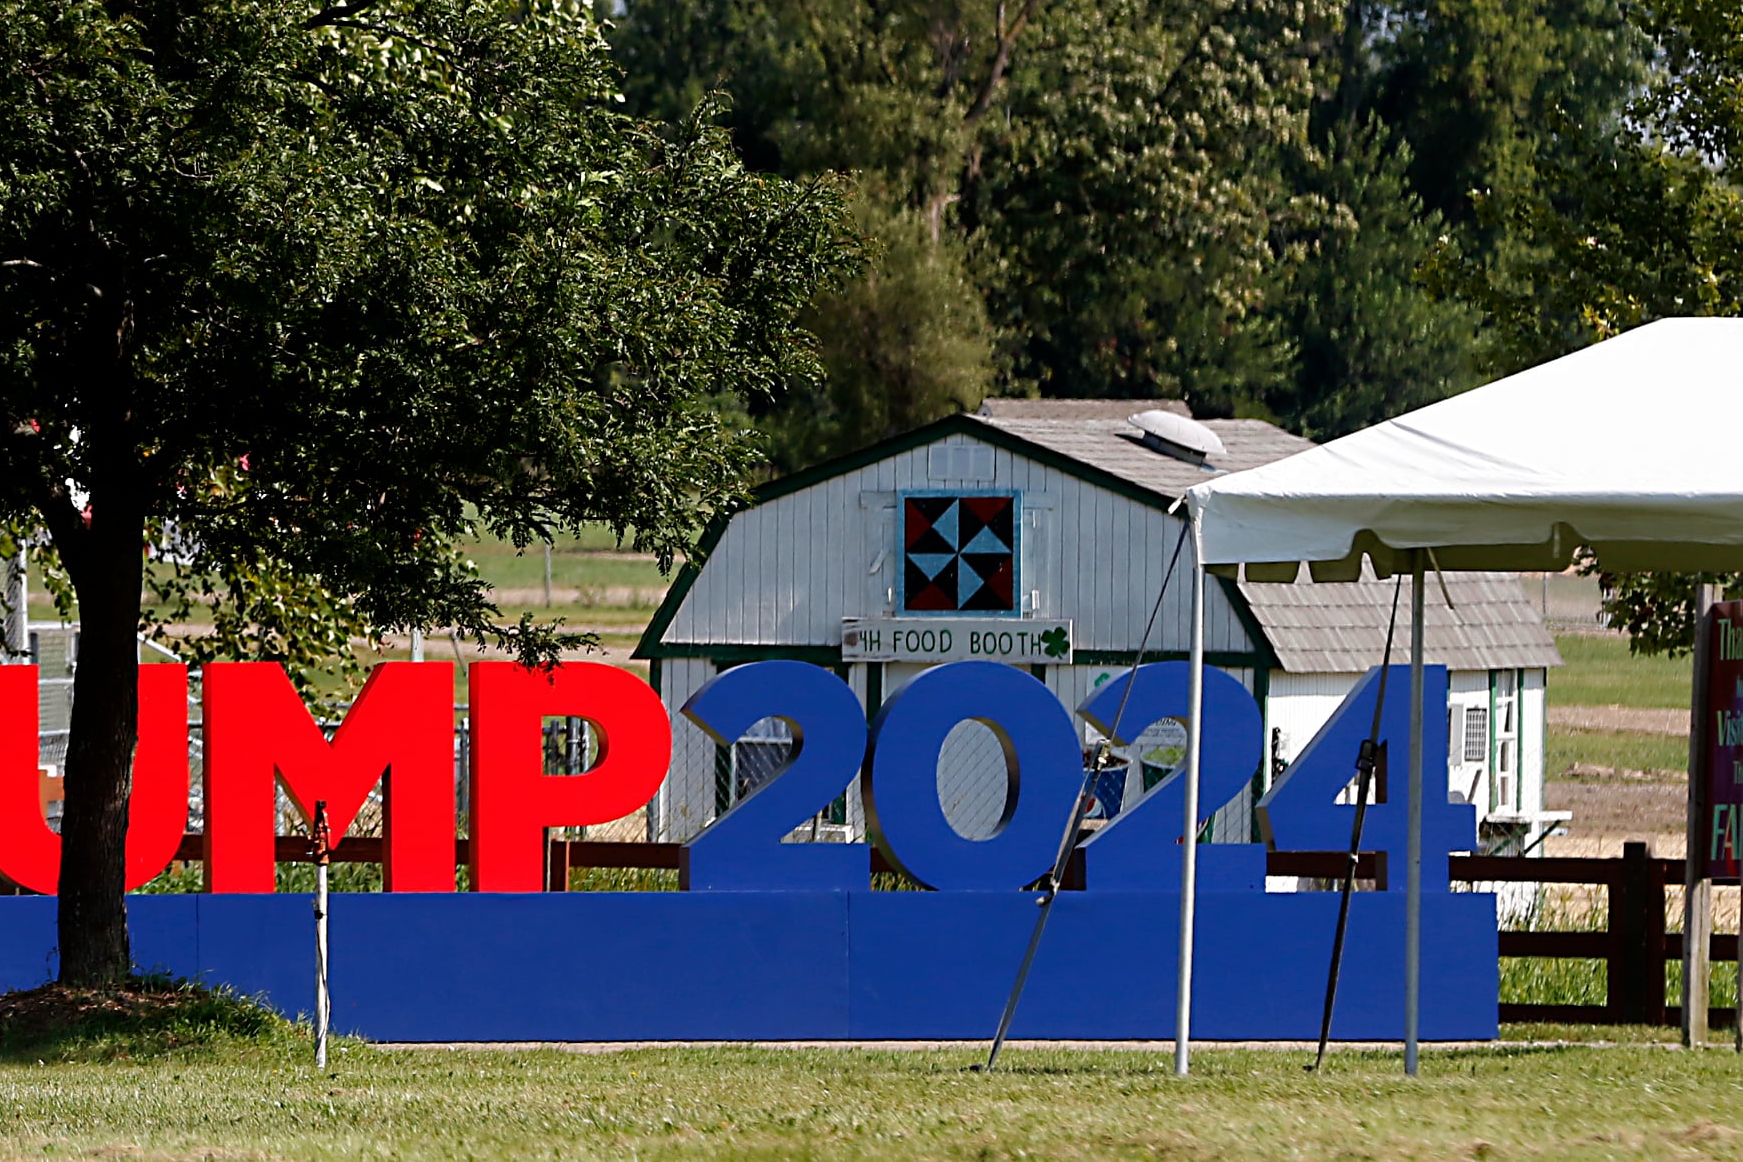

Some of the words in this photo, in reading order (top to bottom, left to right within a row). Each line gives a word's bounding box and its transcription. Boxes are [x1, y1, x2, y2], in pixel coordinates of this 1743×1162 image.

[859, 629, 881, 652] 4H
[892, 628, 953, 654] FOOD
[969, 630, 1042, 656] BOOTH
[679, 660, 1476, 891] 2024
